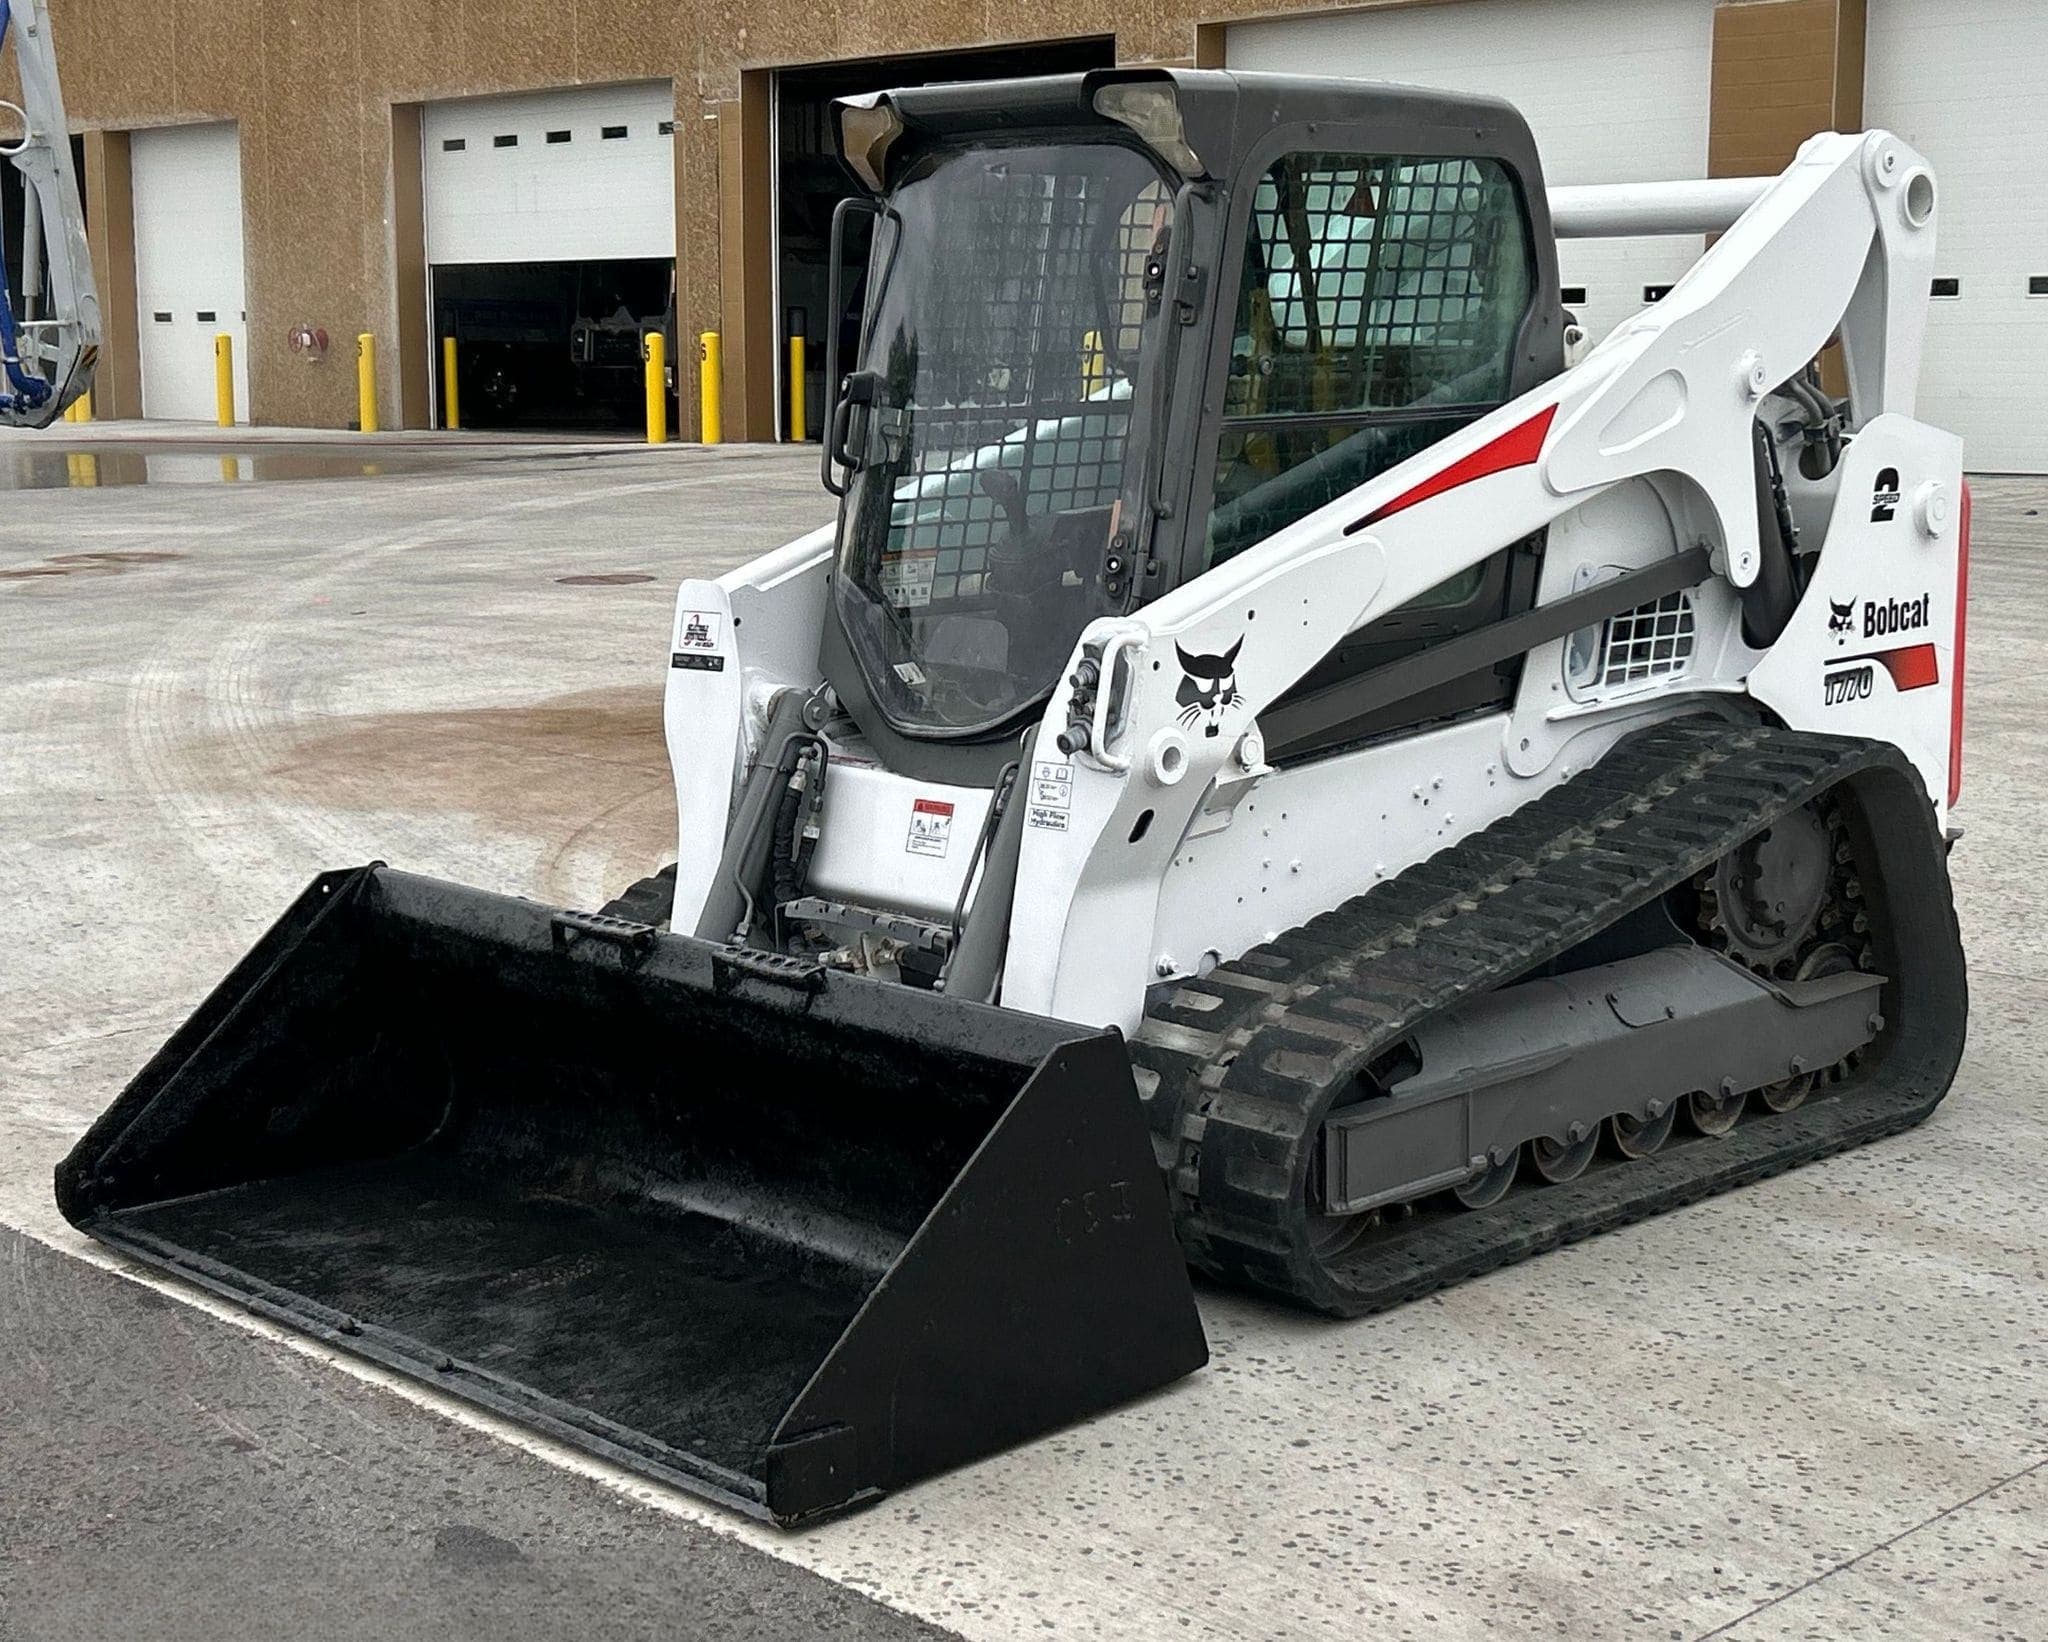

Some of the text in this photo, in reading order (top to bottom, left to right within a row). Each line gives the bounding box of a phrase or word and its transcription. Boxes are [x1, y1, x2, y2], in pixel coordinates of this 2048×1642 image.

[1870, 467, 1900, 523] 2
[1863, 592, 1929, 639] Bobcat
[1824, 665, 1874, 706] T770
